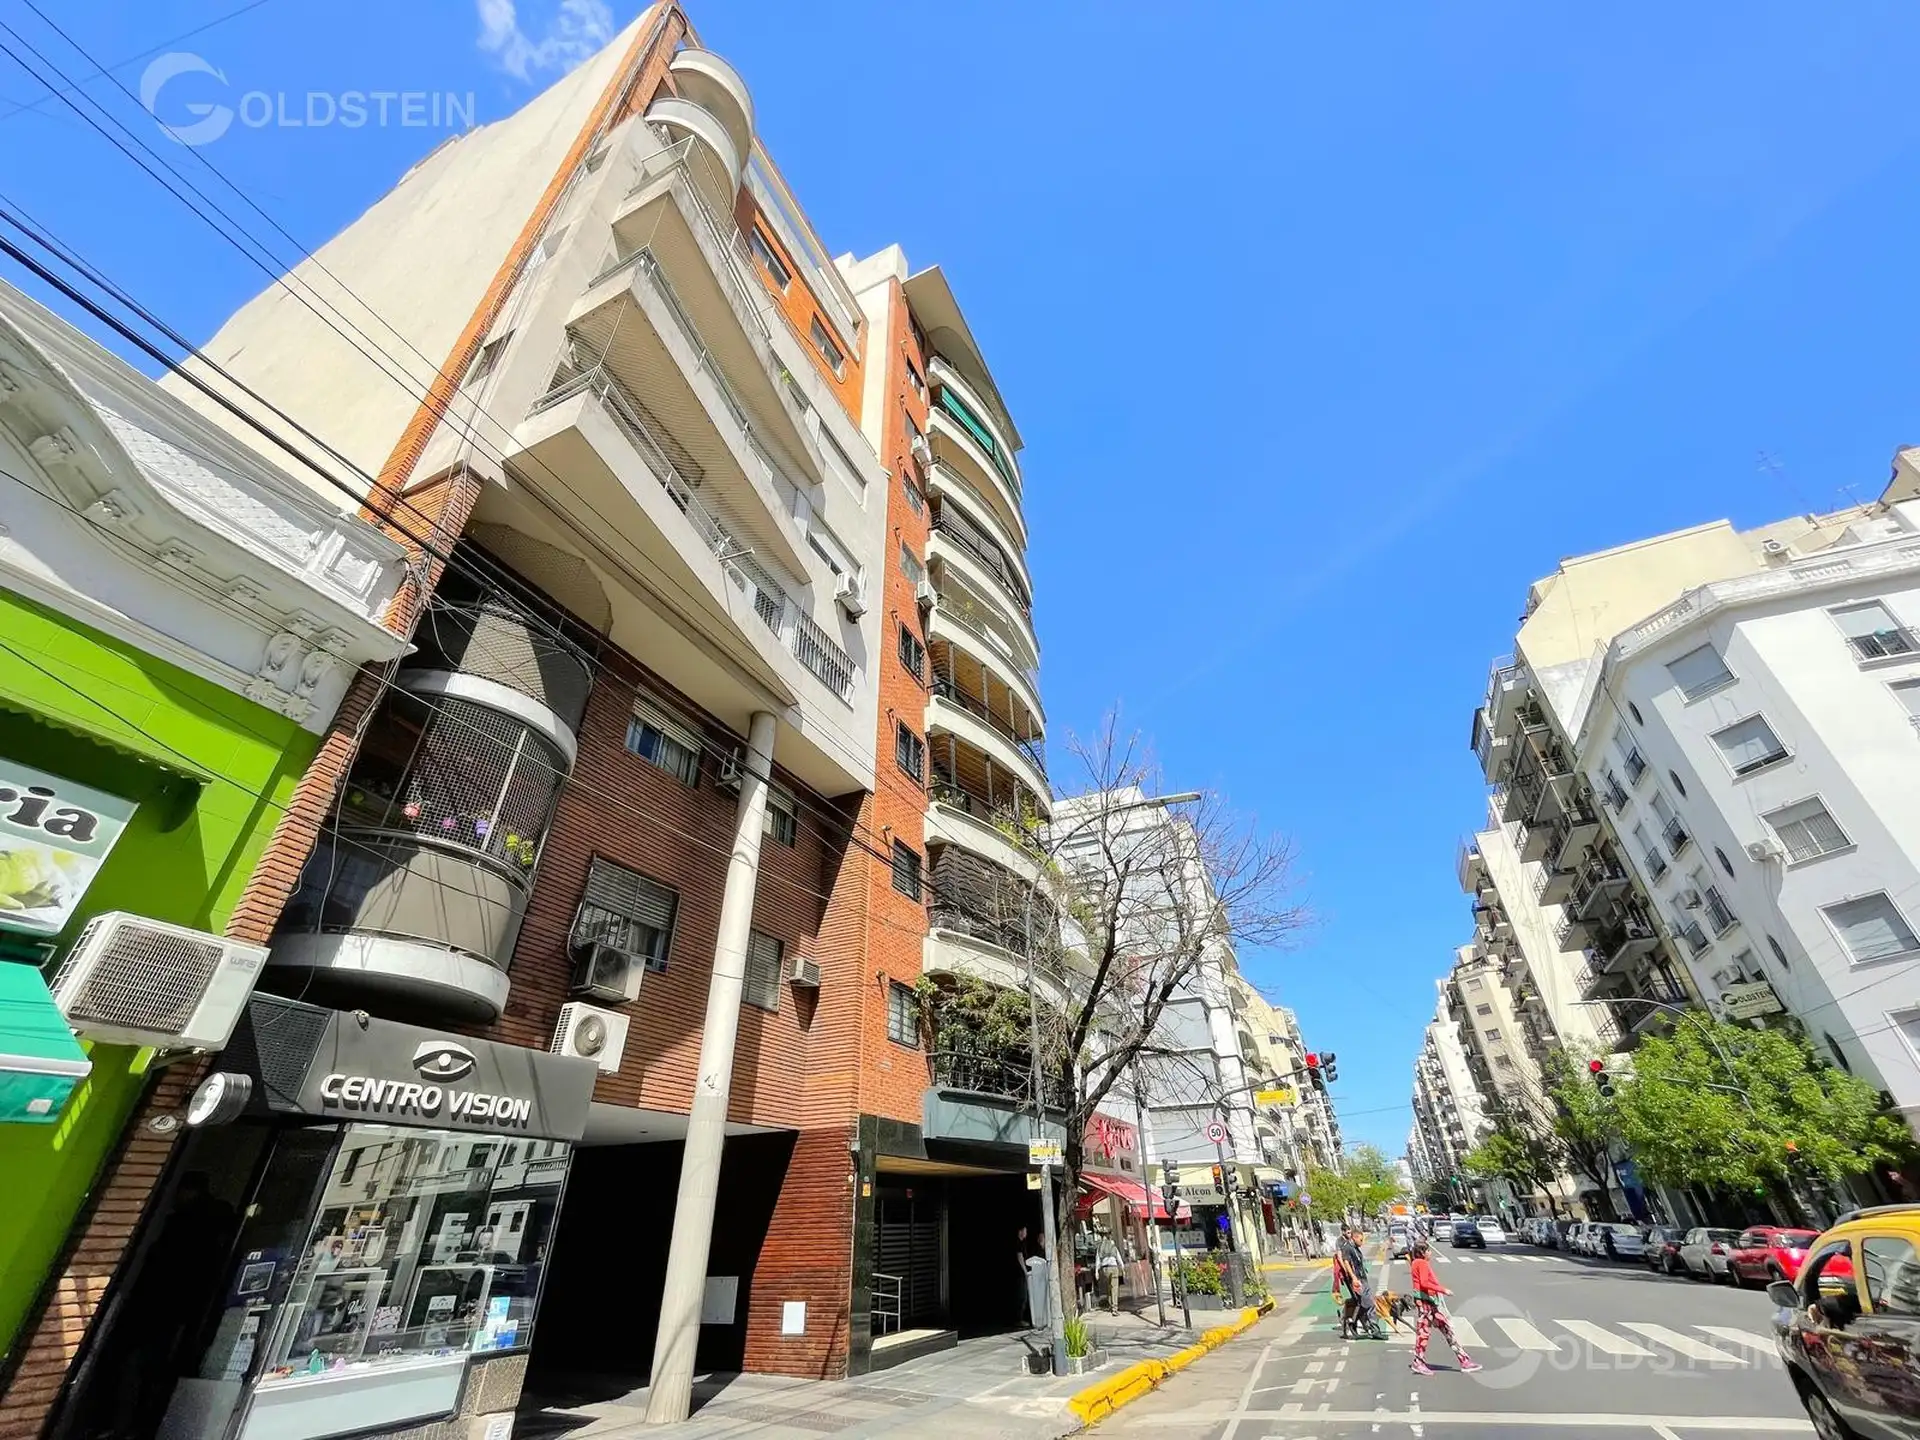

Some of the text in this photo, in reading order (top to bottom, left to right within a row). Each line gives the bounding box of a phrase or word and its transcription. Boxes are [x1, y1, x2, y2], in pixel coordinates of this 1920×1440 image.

[320, 1073, 532, 1122] CENTRO VISION
[1211, 1126, 1221, 1137] 50
[1185, 1186, 1212, 1196] Alcon
